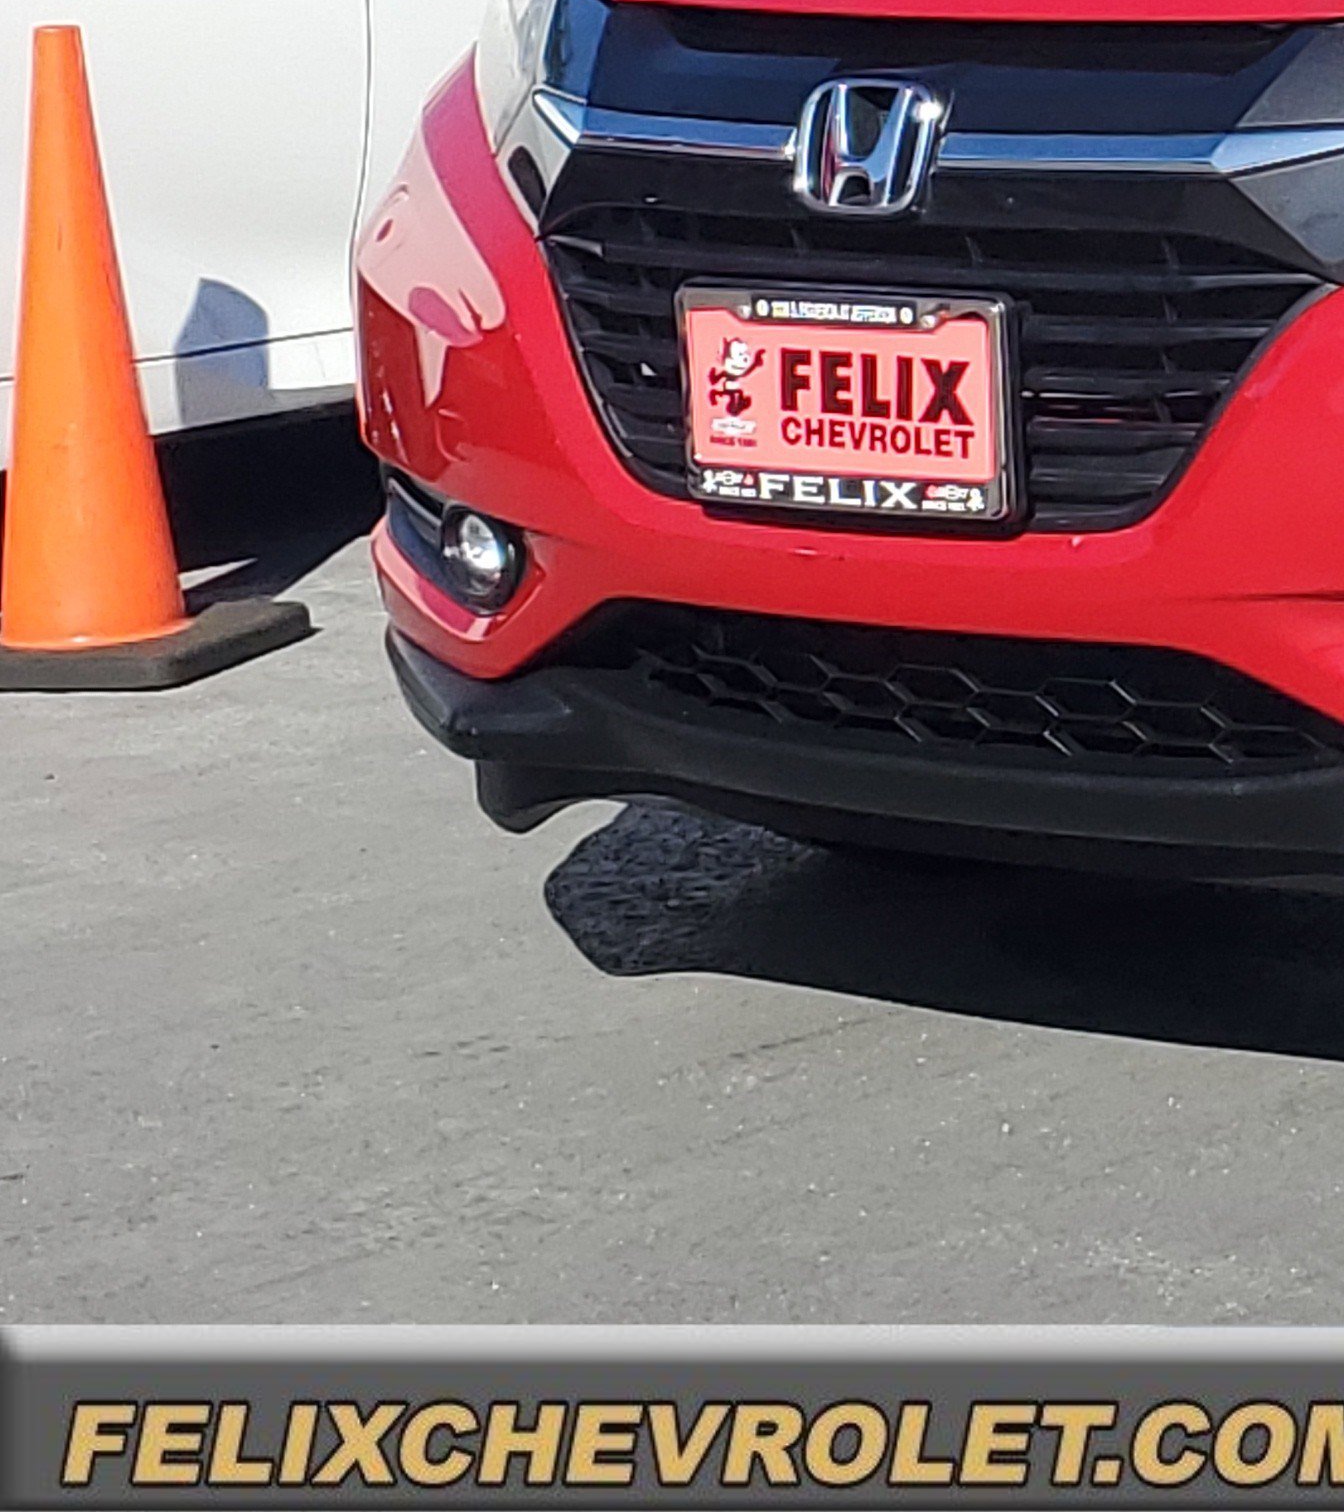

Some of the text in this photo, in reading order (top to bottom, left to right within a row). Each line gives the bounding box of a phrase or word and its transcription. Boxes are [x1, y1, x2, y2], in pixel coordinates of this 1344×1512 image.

[779, 346, 975, 426] FELIX
[780, 416, 976, 460] CHEVROLET
[758, 471, 919, 511] FELIX
